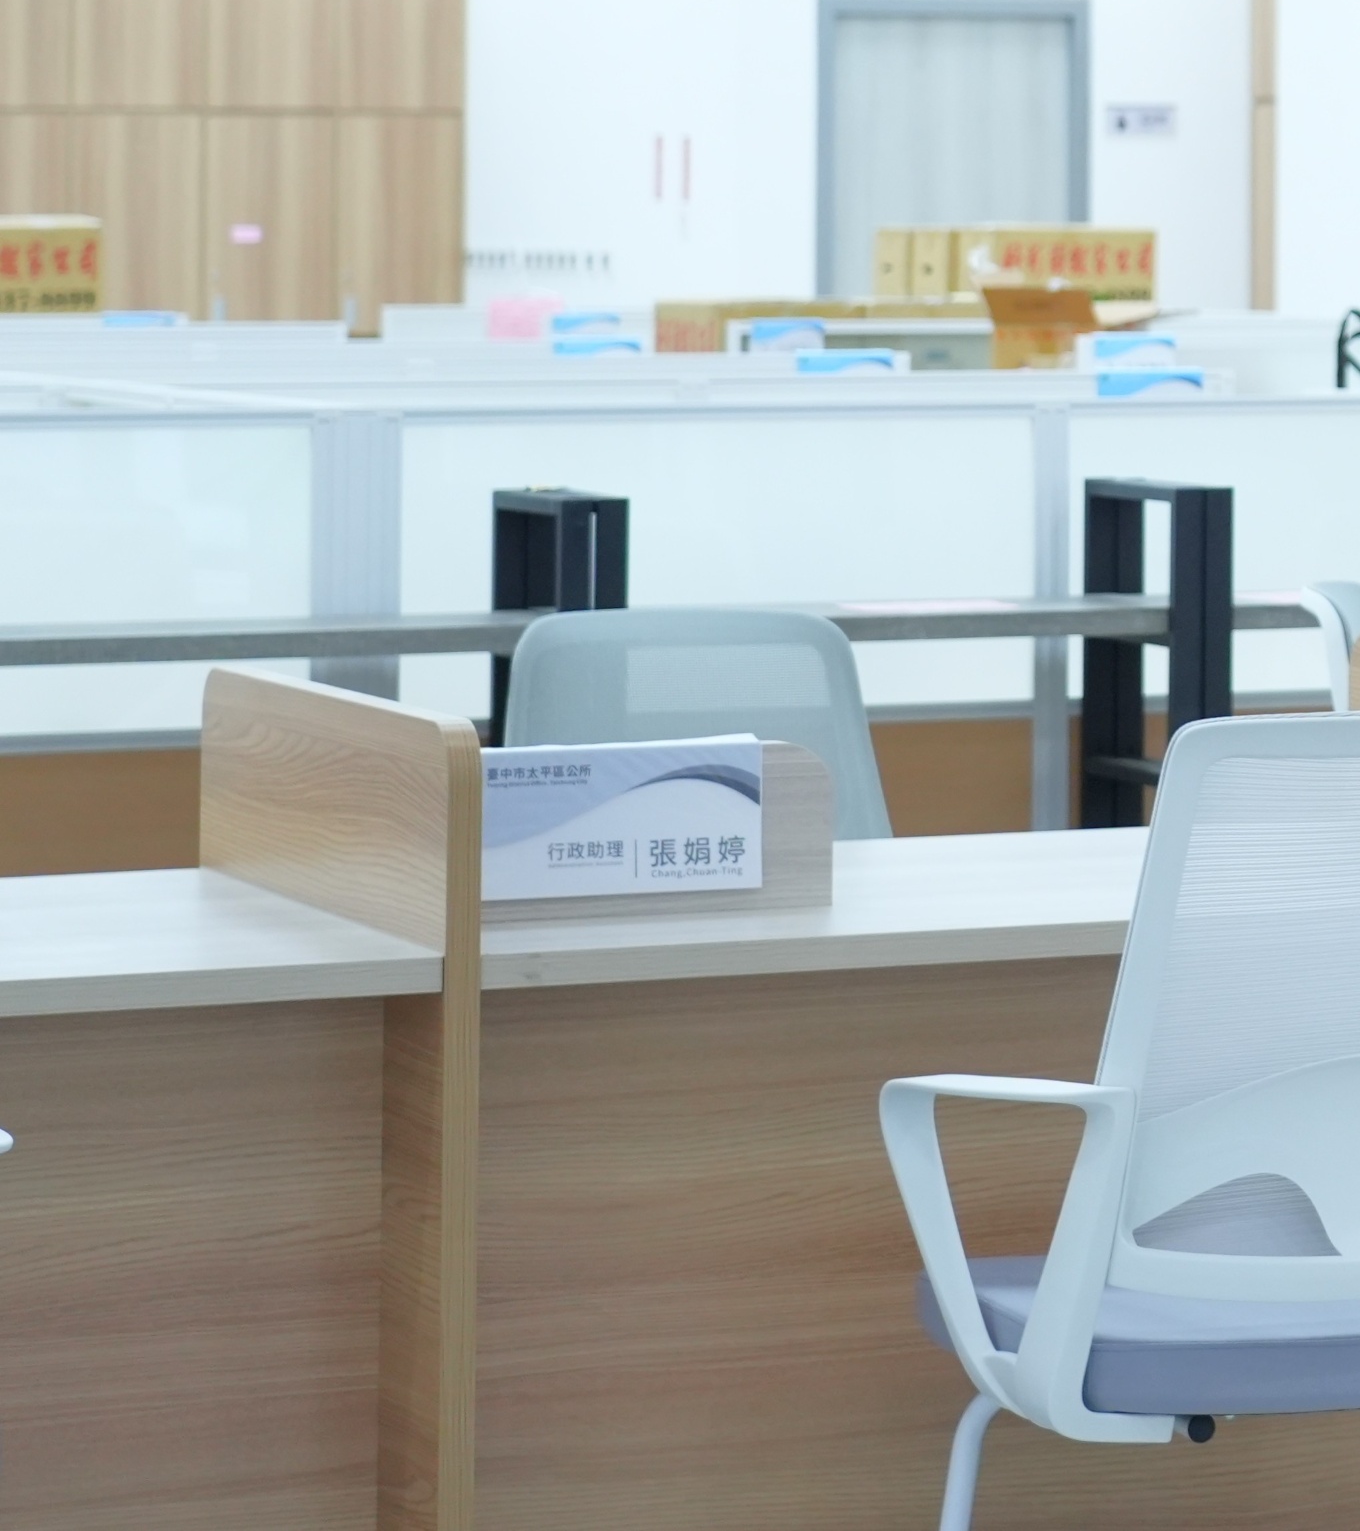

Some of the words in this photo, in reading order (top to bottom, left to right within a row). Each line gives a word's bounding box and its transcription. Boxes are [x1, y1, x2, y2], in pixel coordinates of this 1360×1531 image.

[487, 764, 592, 780] 臺中市太平區公所
[548, 840, 624, 861] 行政助理
[650, 835, 746, 867] 張娟婷
